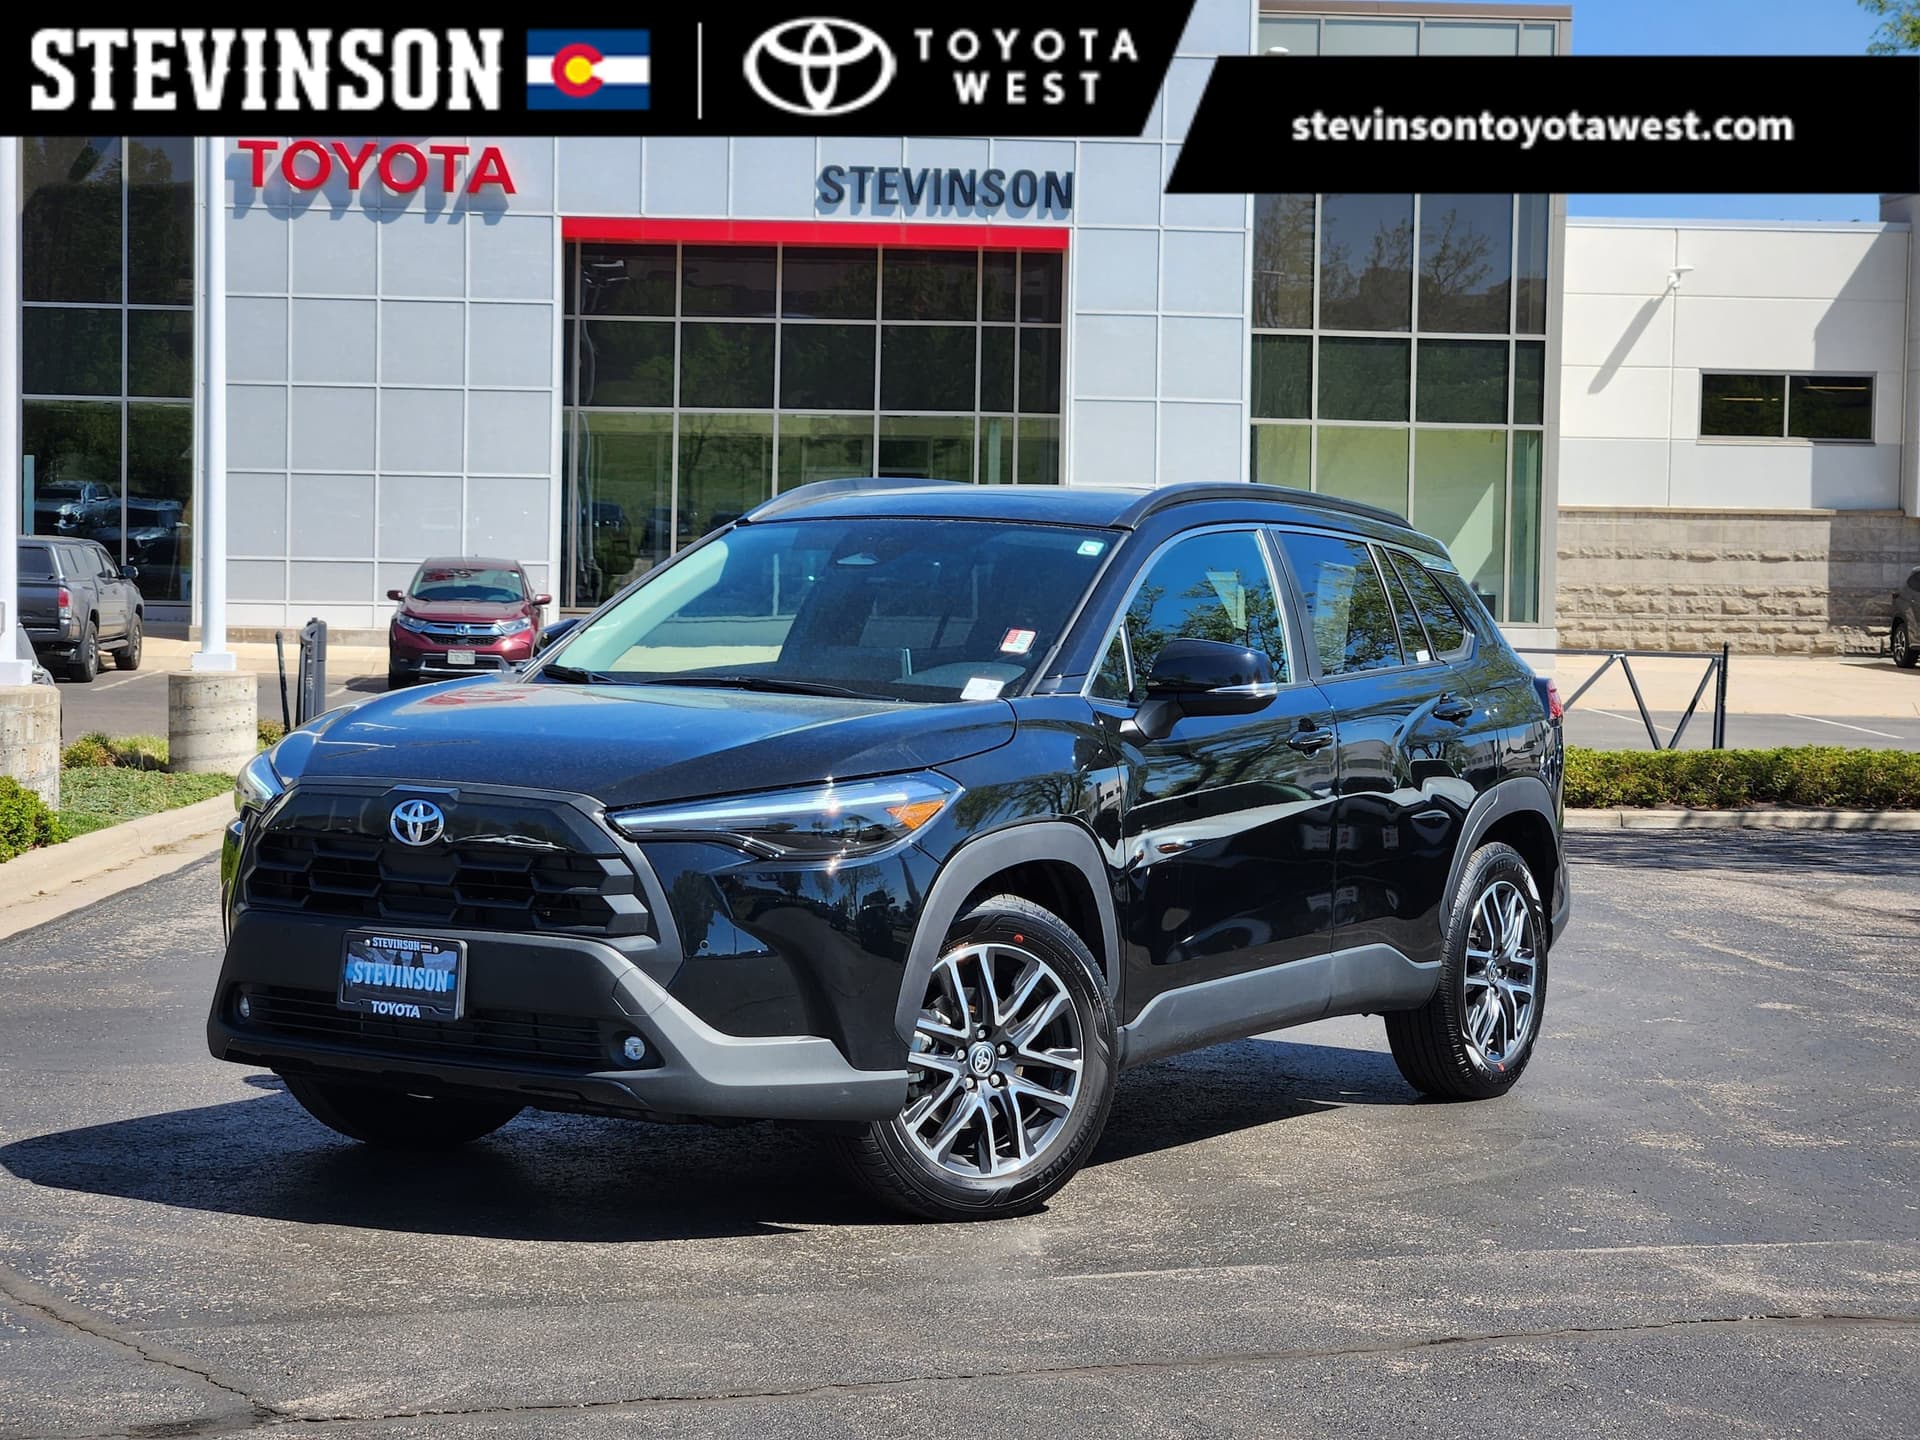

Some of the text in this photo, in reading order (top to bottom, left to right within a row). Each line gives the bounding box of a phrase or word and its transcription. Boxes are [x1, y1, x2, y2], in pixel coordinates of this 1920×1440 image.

[238, 140, 516, 194] TOYOTA
[819, 164, 1074, 209] STEVINSON
[372, 936, 420, 951] STEVINSON
[352, 961, 449, 993] STEVINSON
[371, 1001, 421, 1018] TOYOTA
